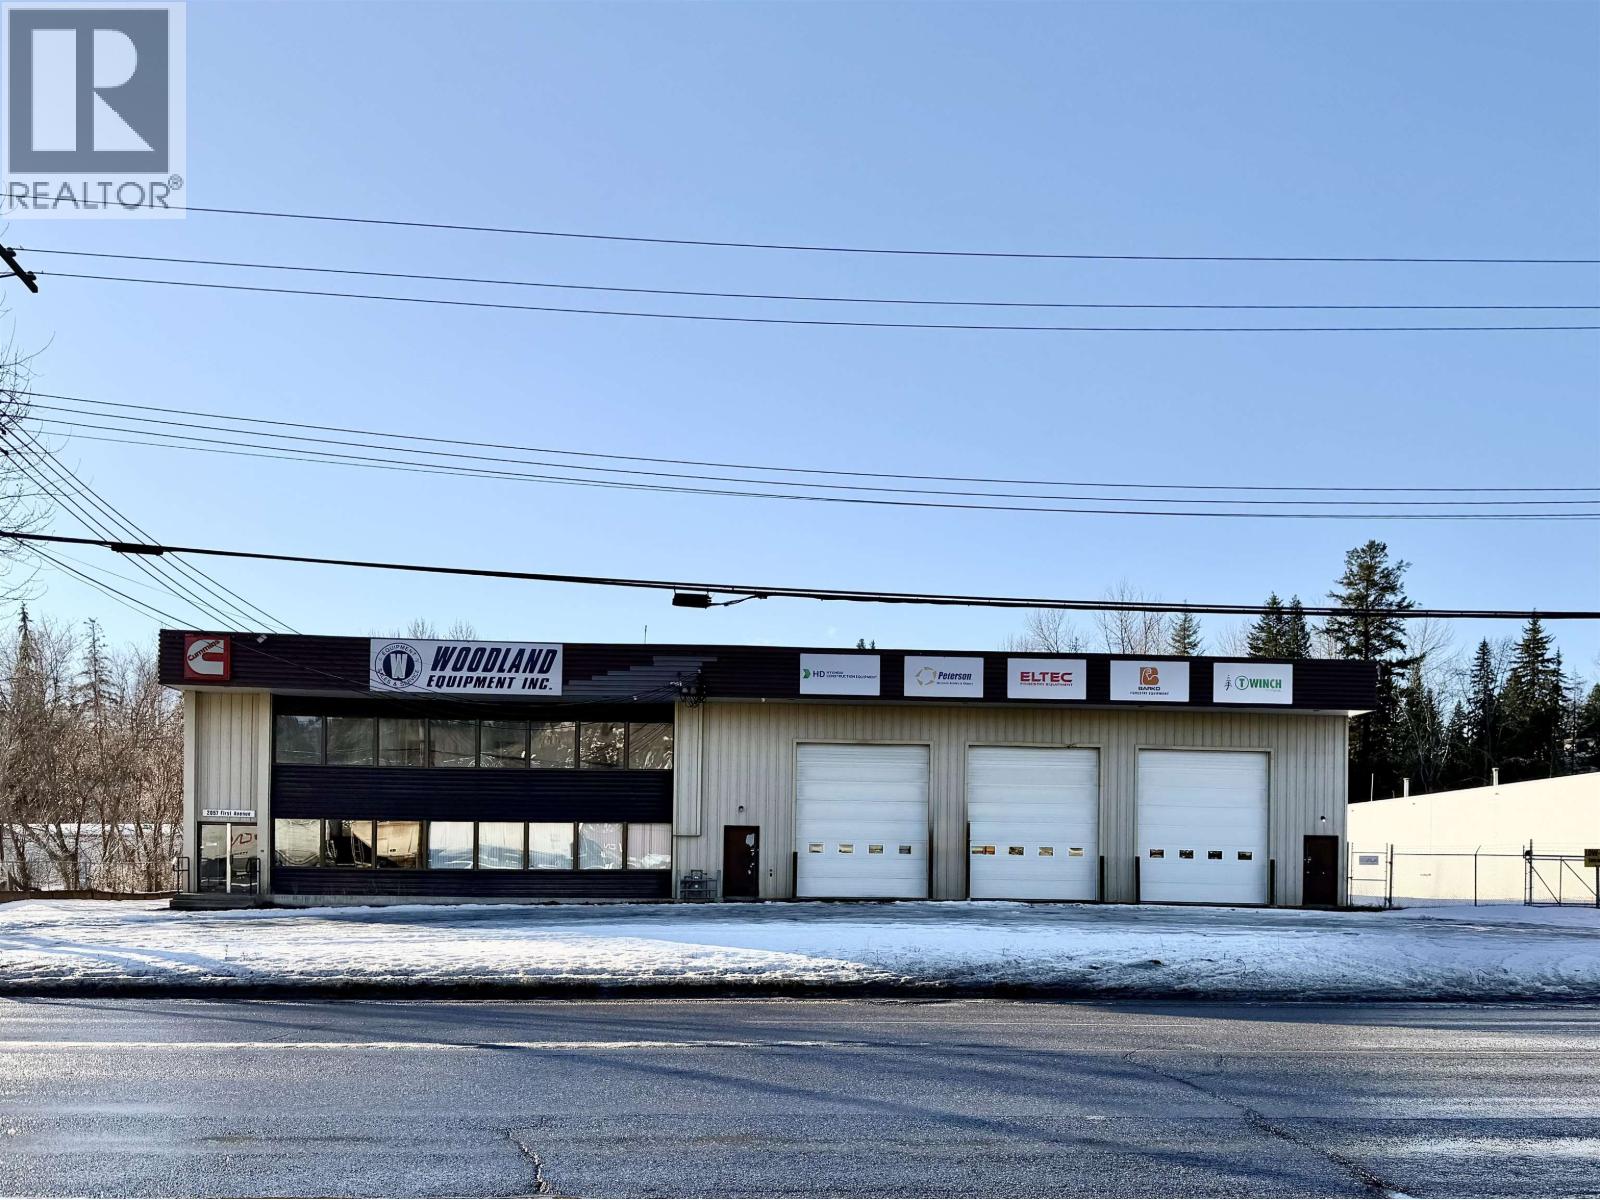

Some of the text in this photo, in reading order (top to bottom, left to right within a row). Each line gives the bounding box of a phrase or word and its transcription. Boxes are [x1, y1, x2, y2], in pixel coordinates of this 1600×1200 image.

[430, 645, 558, 674] WOODLAND
[812, 670, 826, 678] HD
[938, 671, 972, 681] Peterson
[1020, 671, 1073, 683] ELTEC
[426, 674, 553, 690] EQUIPMENT INC.
